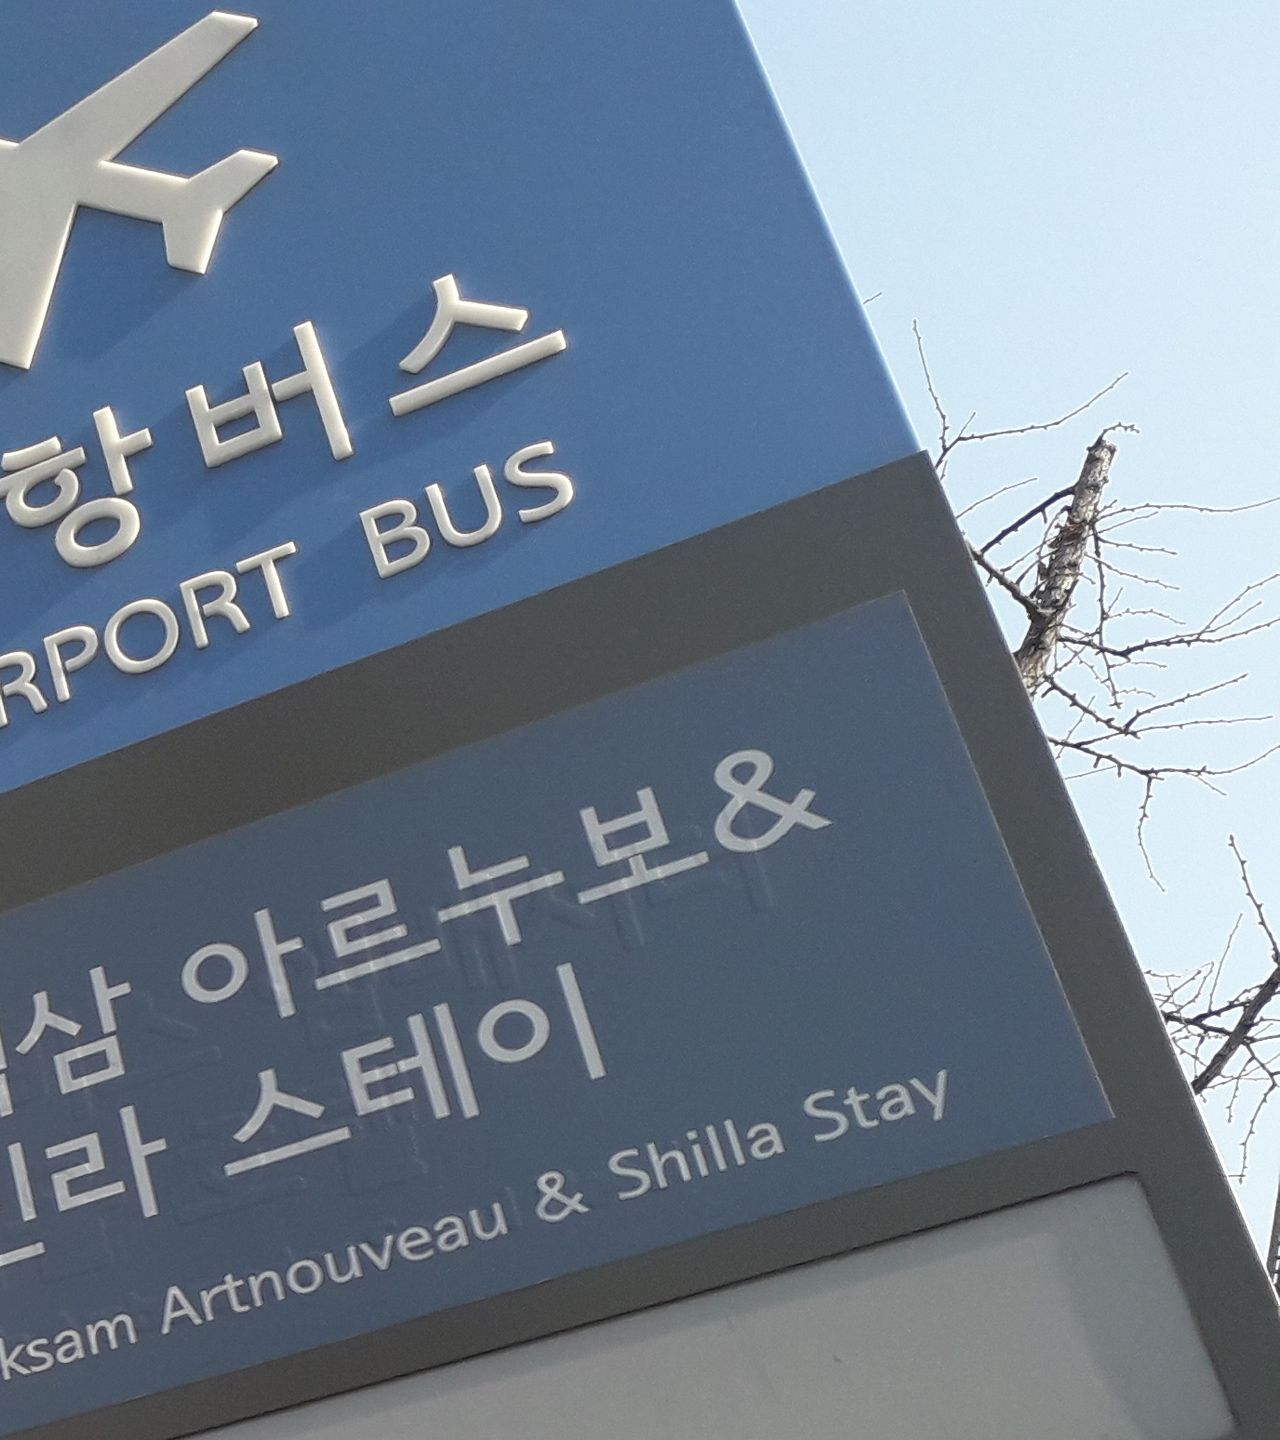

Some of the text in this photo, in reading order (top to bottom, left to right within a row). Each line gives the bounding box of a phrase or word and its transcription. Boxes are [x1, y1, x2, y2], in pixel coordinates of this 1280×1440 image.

[358, 440, 575, 579] BUS
[224, 962, 606, 1176] 스테이
[161, 1201, 509, 1335] Artnouveau
[535, 1170, 590, 1223] &
[607, 1119, 786, 1200] Shilla
[802, 1068, 948, 1142] Stay
